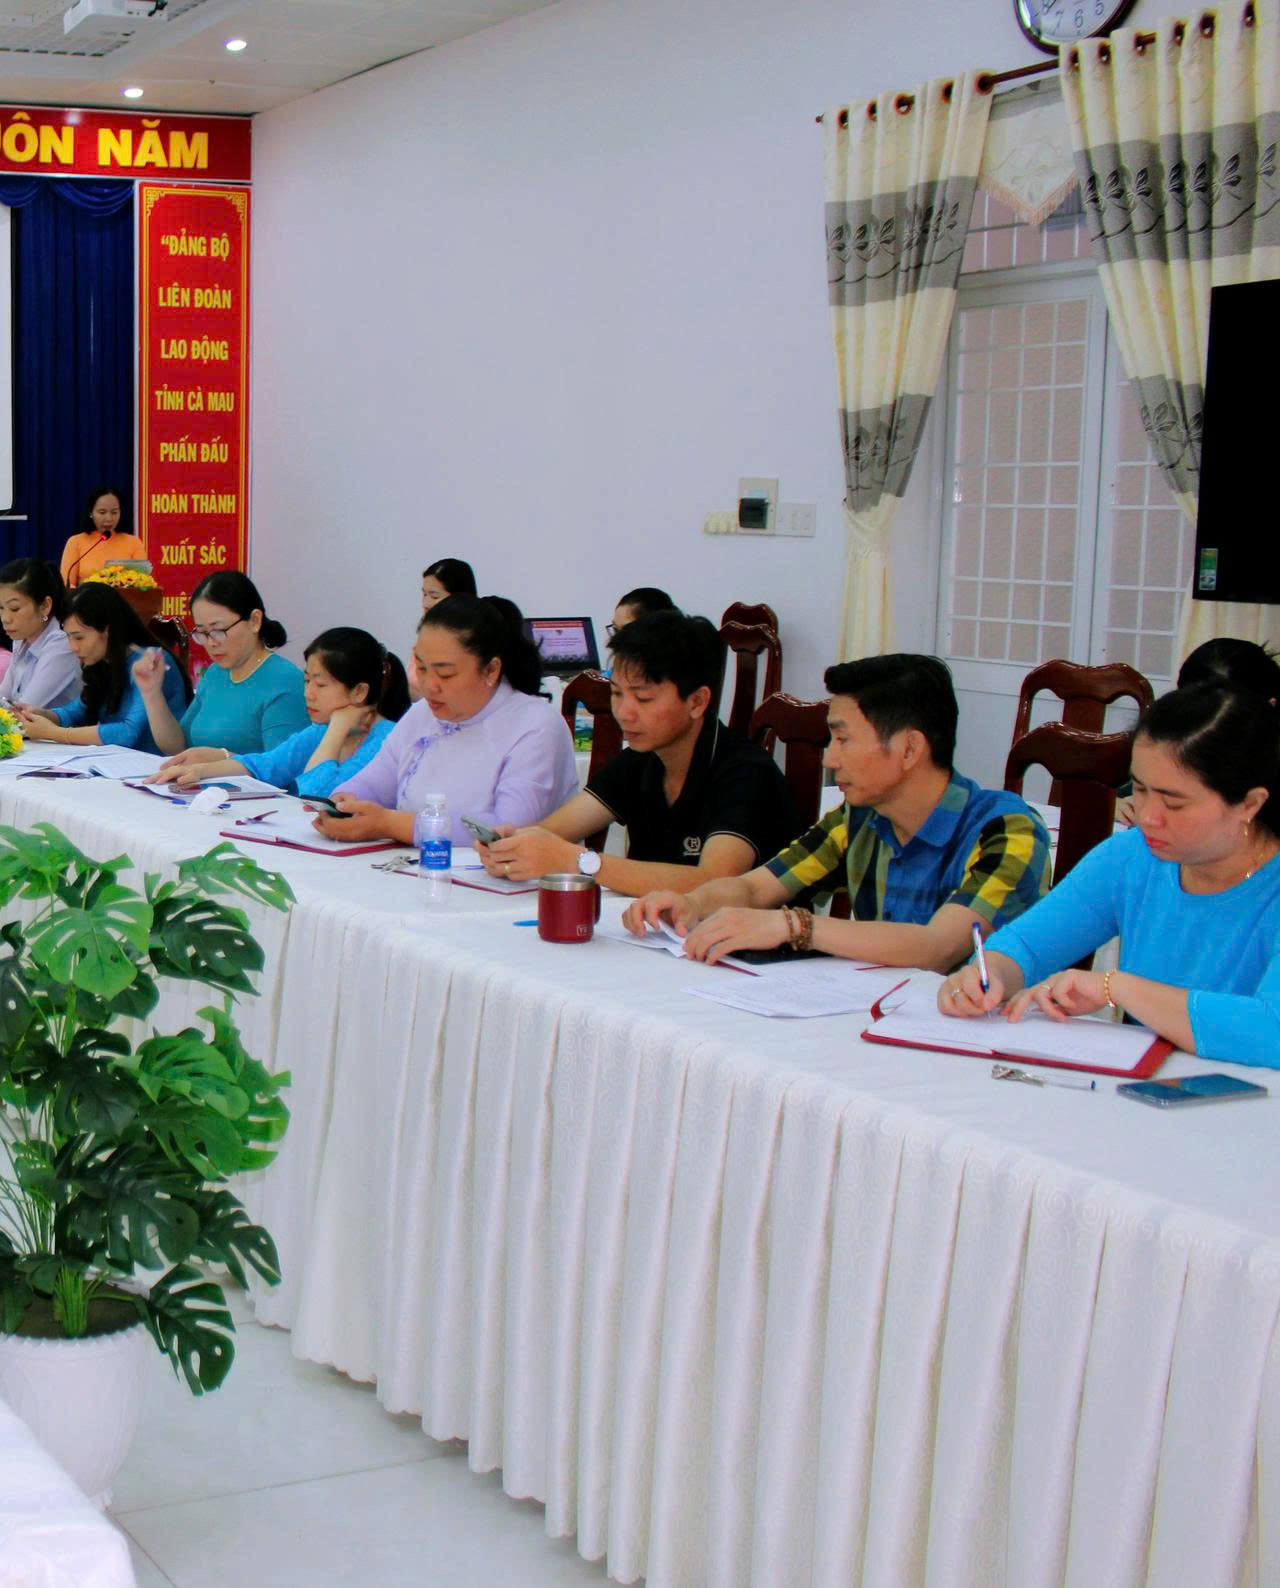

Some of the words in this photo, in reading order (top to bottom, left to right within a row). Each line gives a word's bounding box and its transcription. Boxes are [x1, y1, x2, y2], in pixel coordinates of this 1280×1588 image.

[98, 119, 208, 169] NĂM
[210, 233, 230, 261] BỘ
[158, 282, 190, 308] LIÊN
[194, 284, 232, 309] ĐOÀN
[160, 339, 187, 360] LAO
[191, 335, 229, 363] ĐỘNG
[155, 383, 184, 411] TỈNH
[187, 386, 204, 411] CÀ
[208, 391, 234, 412] MAU
[160, 435, 197, 462] PHẤN
[200, 436, 229, 463] ĐẤU
[151, 490, 188, 513] HOÀN
[192, 490, 236, 514] THÀNH
[161, 538, 196, 565] XUẤT
[199, 537, 227, 565] SẮC
